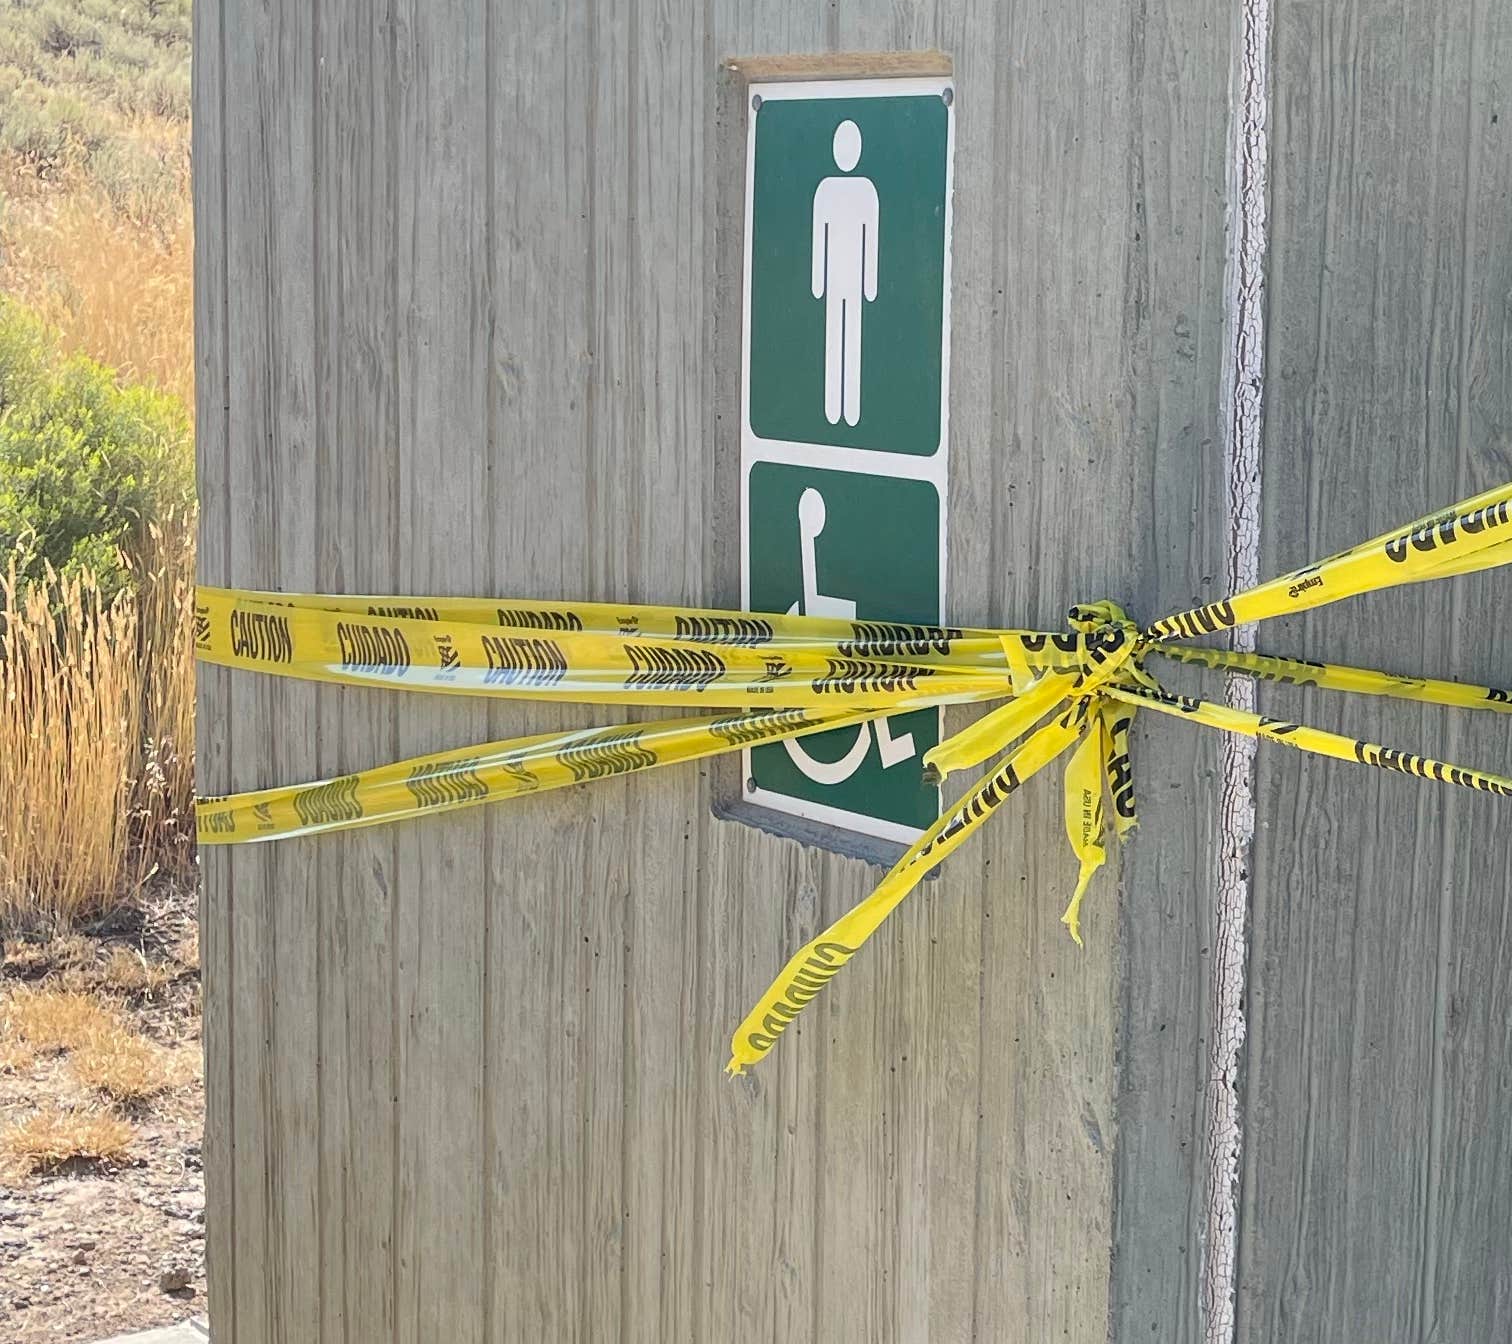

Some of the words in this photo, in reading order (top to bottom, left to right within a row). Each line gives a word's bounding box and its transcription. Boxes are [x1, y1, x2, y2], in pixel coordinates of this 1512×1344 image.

[230, 609, 293, 665] CAUTION
[336, 621, 412, 678] CUIDADO
[481, 635, 568, 687] CAUTION
[623, 644, 727, 693] CUIDADO
